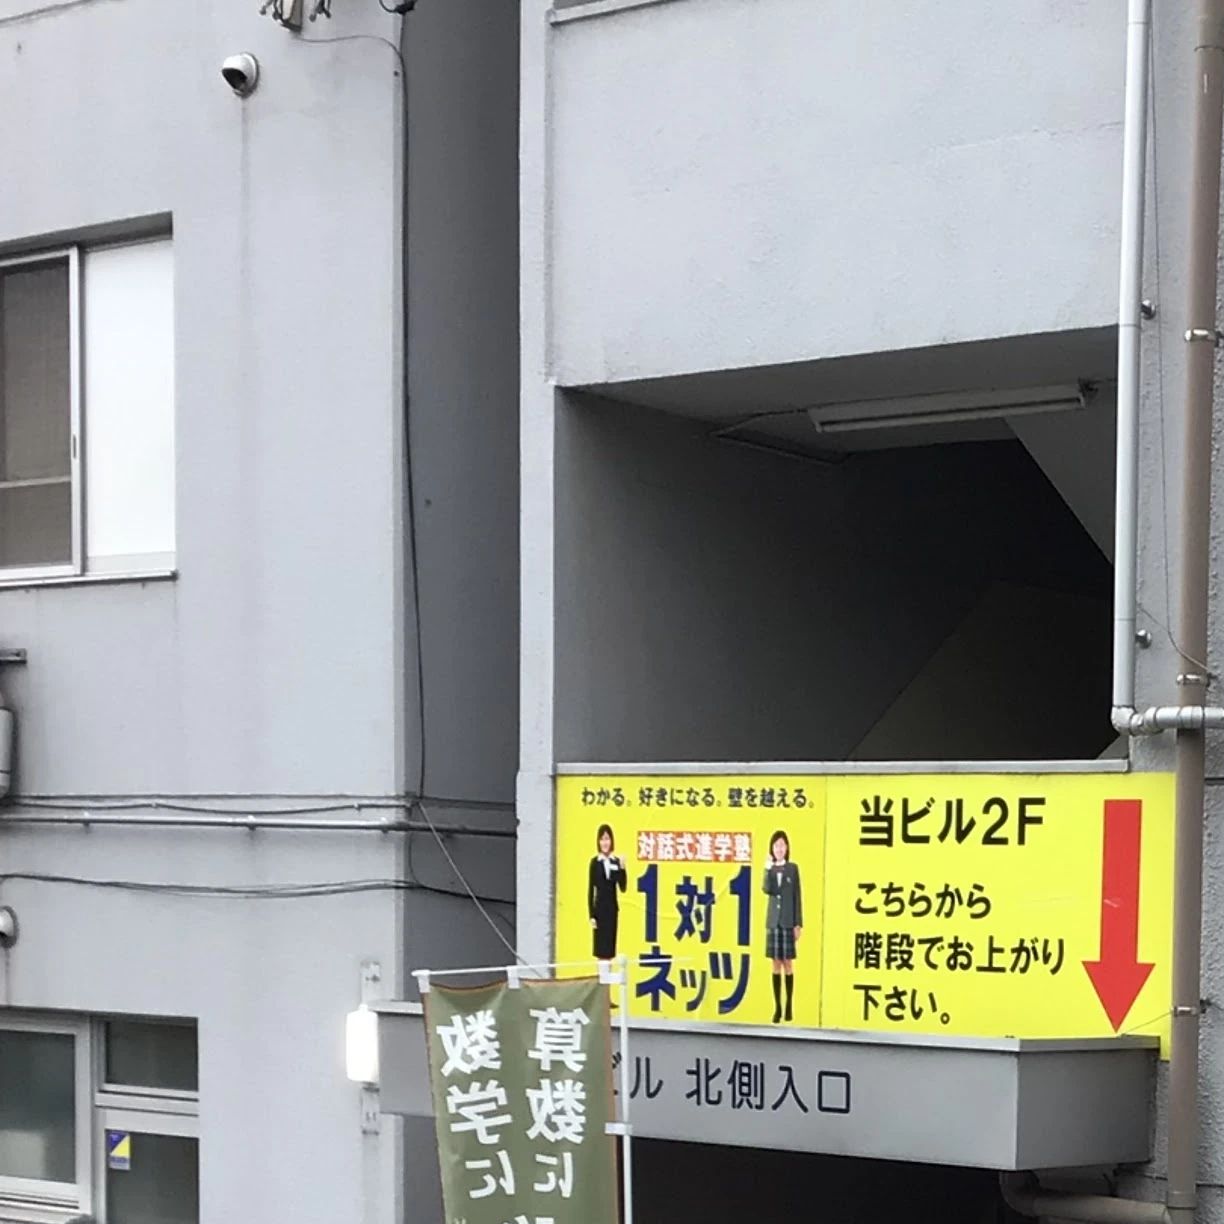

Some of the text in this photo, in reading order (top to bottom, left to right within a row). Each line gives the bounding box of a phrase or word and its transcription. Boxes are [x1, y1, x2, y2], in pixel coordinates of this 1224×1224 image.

[858, 796, 1046, 847] 当ビル2F
[638, 832, 751, 861] 対話式進学塾
[637, 864, 751, 946] 1対1
[855, 882, 992, 920] こちらから
[853, 931, 1066, 975] 階段でお上がり
[636, 946, 751, 1014] ネッツ
[853, 985, 952, 1024] 下さい。
[612, 1052, 850, 1114] ル 北側入口
